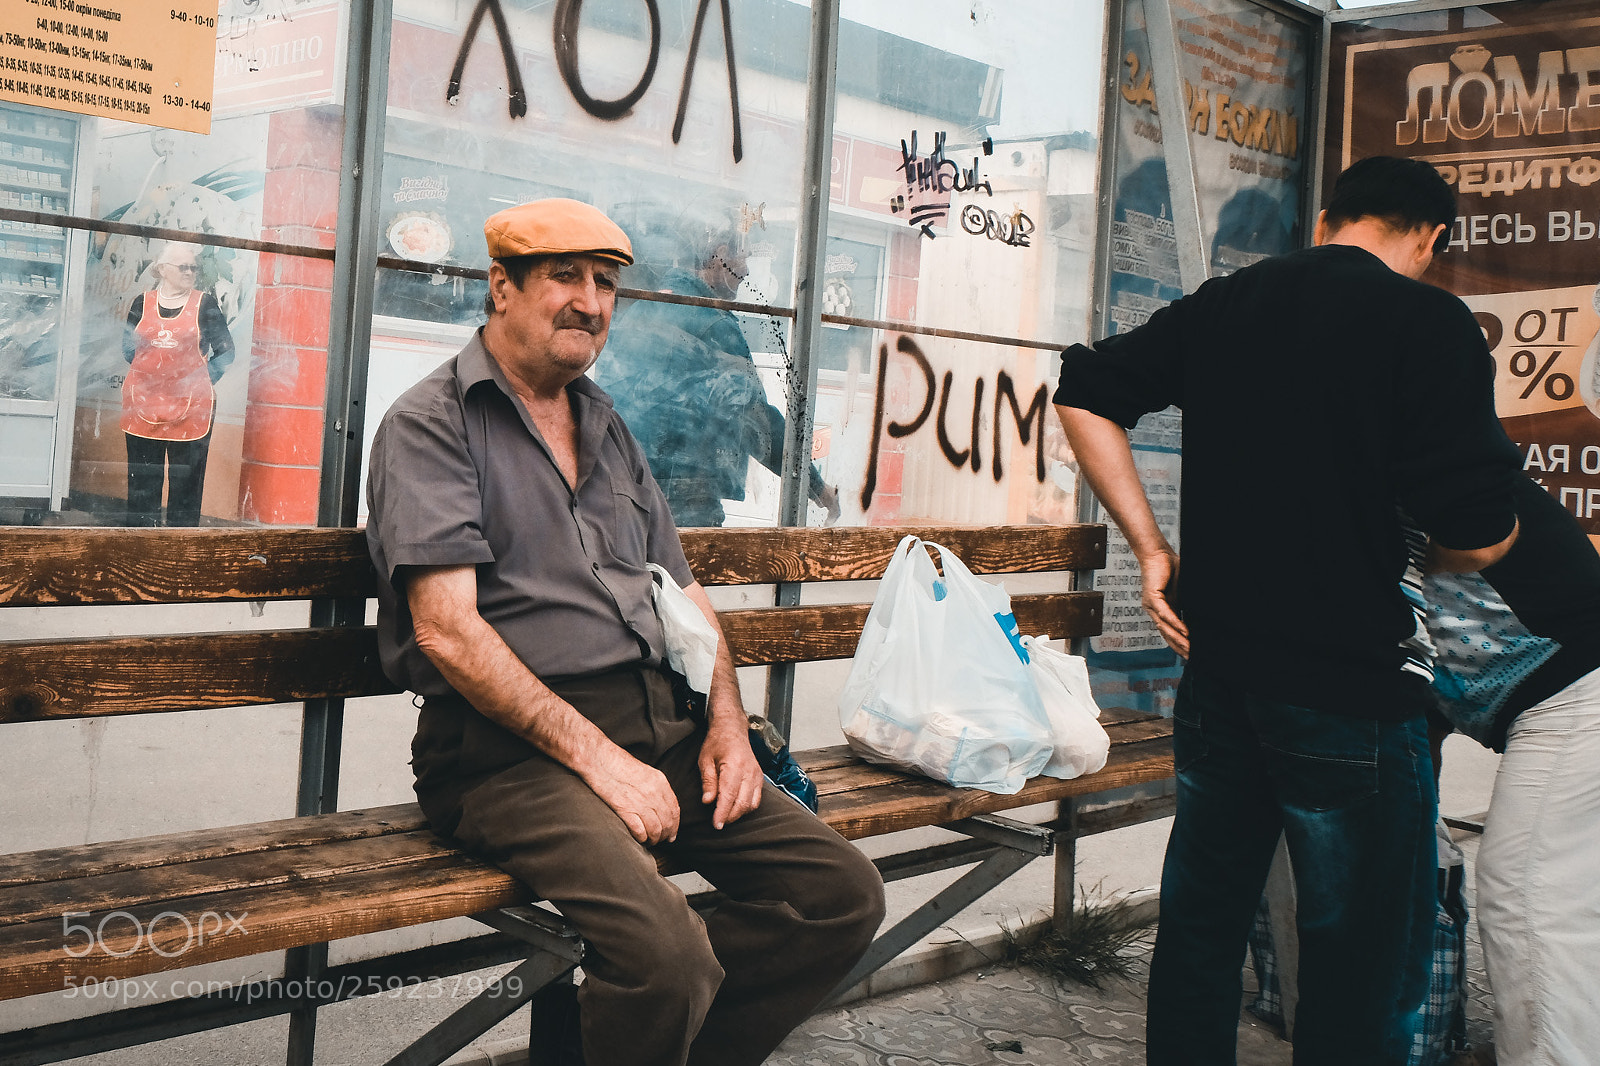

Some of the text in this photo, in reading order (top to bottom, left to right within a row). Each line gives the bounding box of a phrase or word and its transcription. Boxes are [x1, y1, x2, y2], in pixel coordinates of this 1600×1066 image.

[170, 9, 187, 22] 9-40
[194, 14, 214, 28] 10-10
[162, 94, 183, 107] 13-30
[190, 99, 211, 112] 14-40
[1514, 307, 1579, 343] ОТ
[1509, 350, 1575, 401] %
[1516, 443, 1570, 473] АЯ
